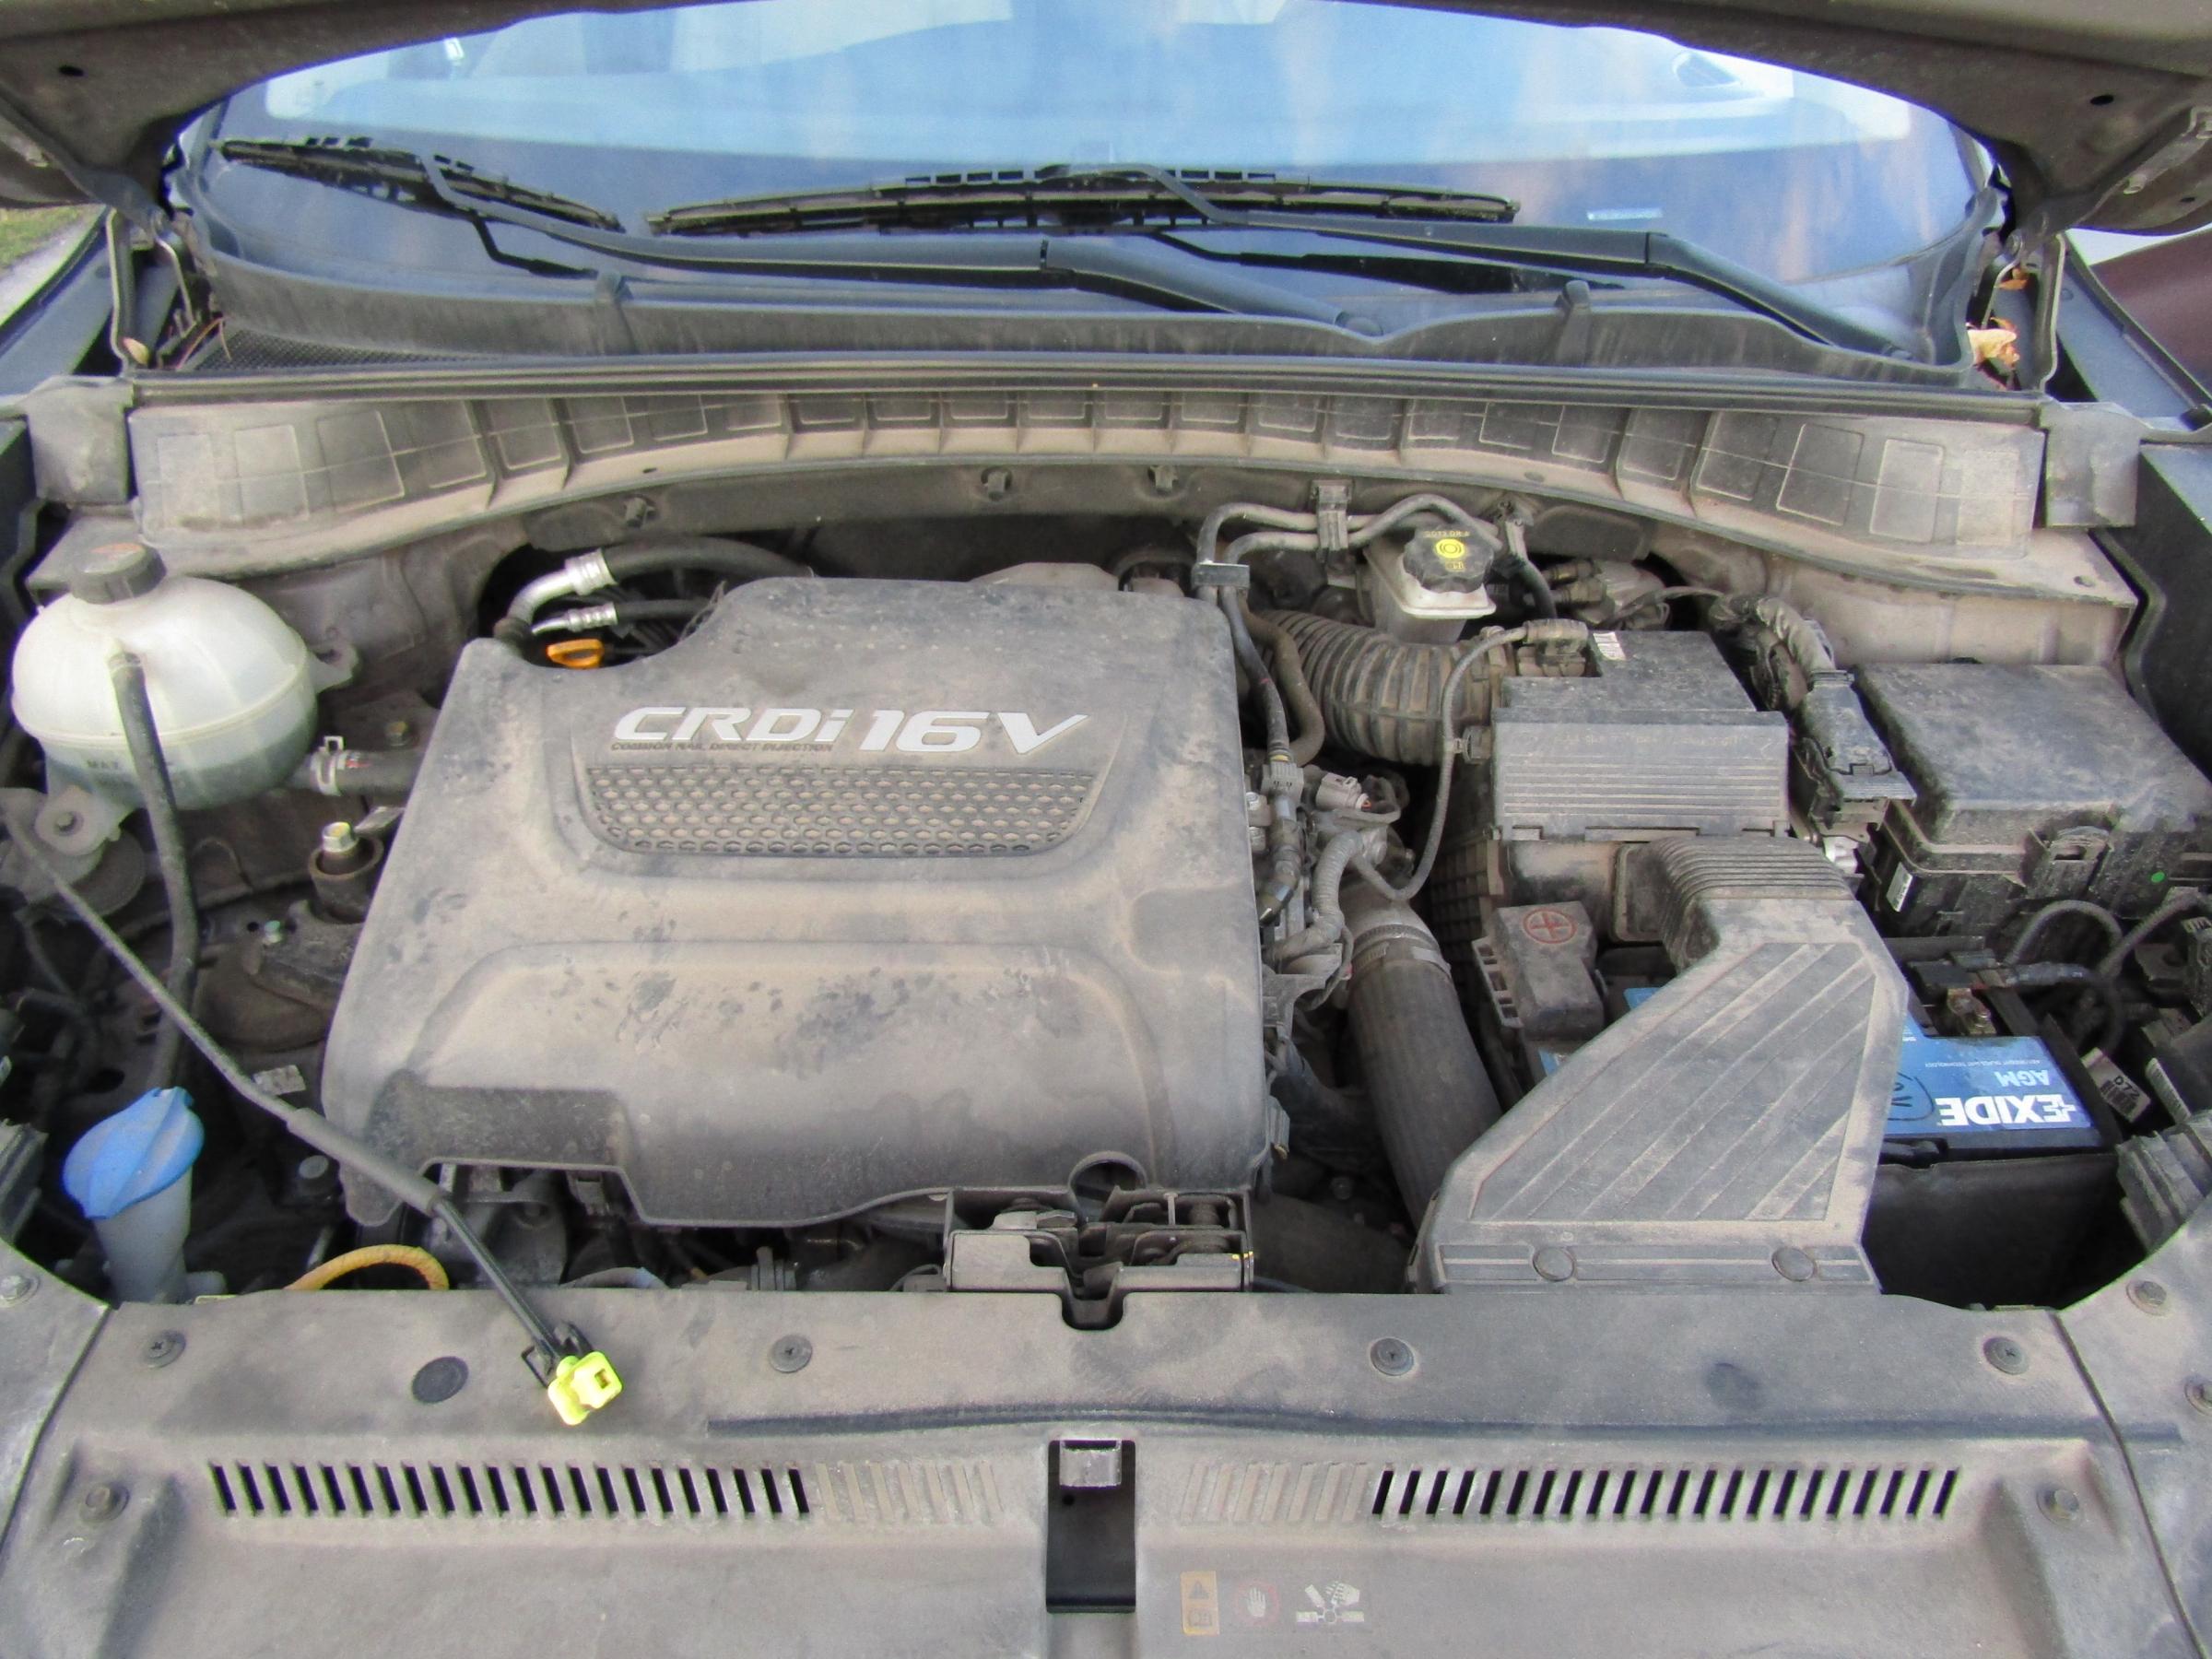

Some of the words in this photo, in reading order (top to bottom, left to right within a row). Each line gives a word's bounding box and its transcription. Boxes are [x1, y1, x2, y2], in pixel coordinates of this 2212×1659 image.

[614, 706, 854, 742] CRDi
[859, 709, 1089, 755] 16V
[1994, 1068, 2050, 1088] AGM
[1935, 1093, 2077, 1126] EXIDE
